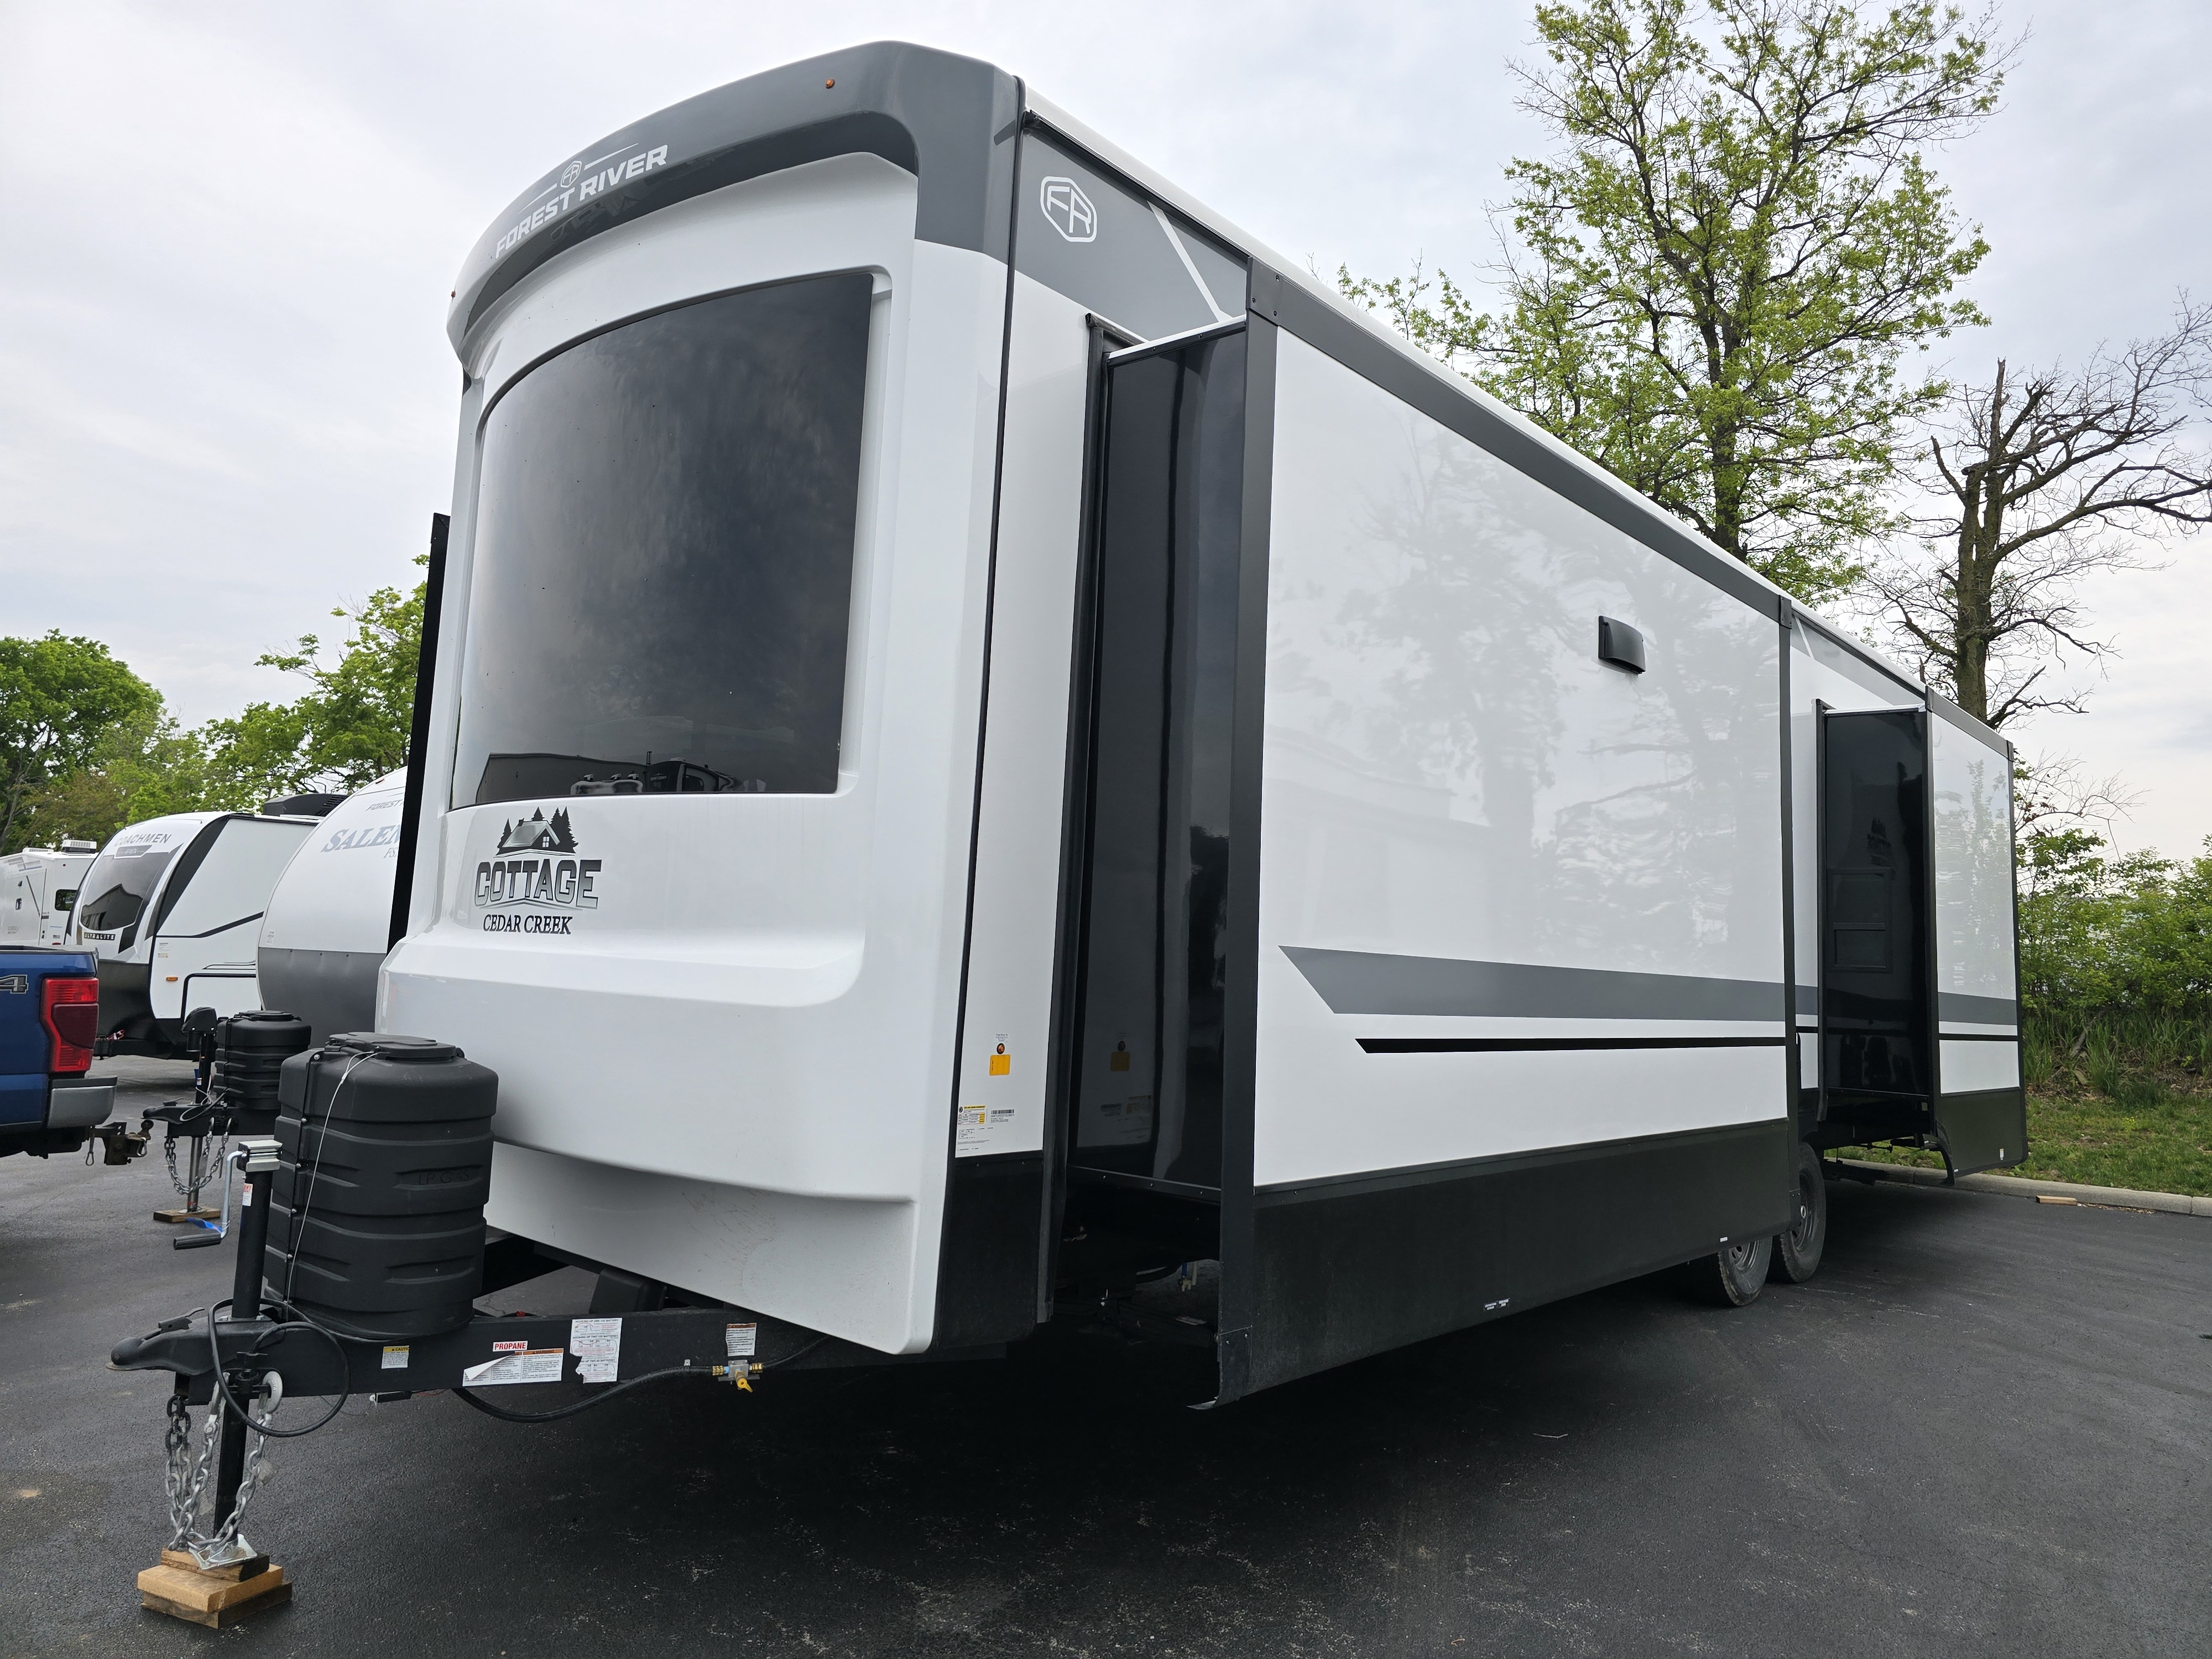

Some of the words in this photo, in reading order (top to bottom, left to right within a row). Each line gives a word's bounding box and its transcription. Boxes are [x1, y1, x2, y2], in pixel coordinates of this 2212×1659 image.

[495, 187, 575, 259] FOREST
[580, 144, 668, 201] RIVER
[365, 799, 403, 812] FOREST
[114, 833, 172, 846] COACHMEN
[383, 847, 399, 858] FS
[474, 858, 602, 910] COTTAGE
[483, 914, 521, 933] CEDAR
[524, 915, 573, 935] CREEK
[494, 1342, 526, 1350] PROPANE
